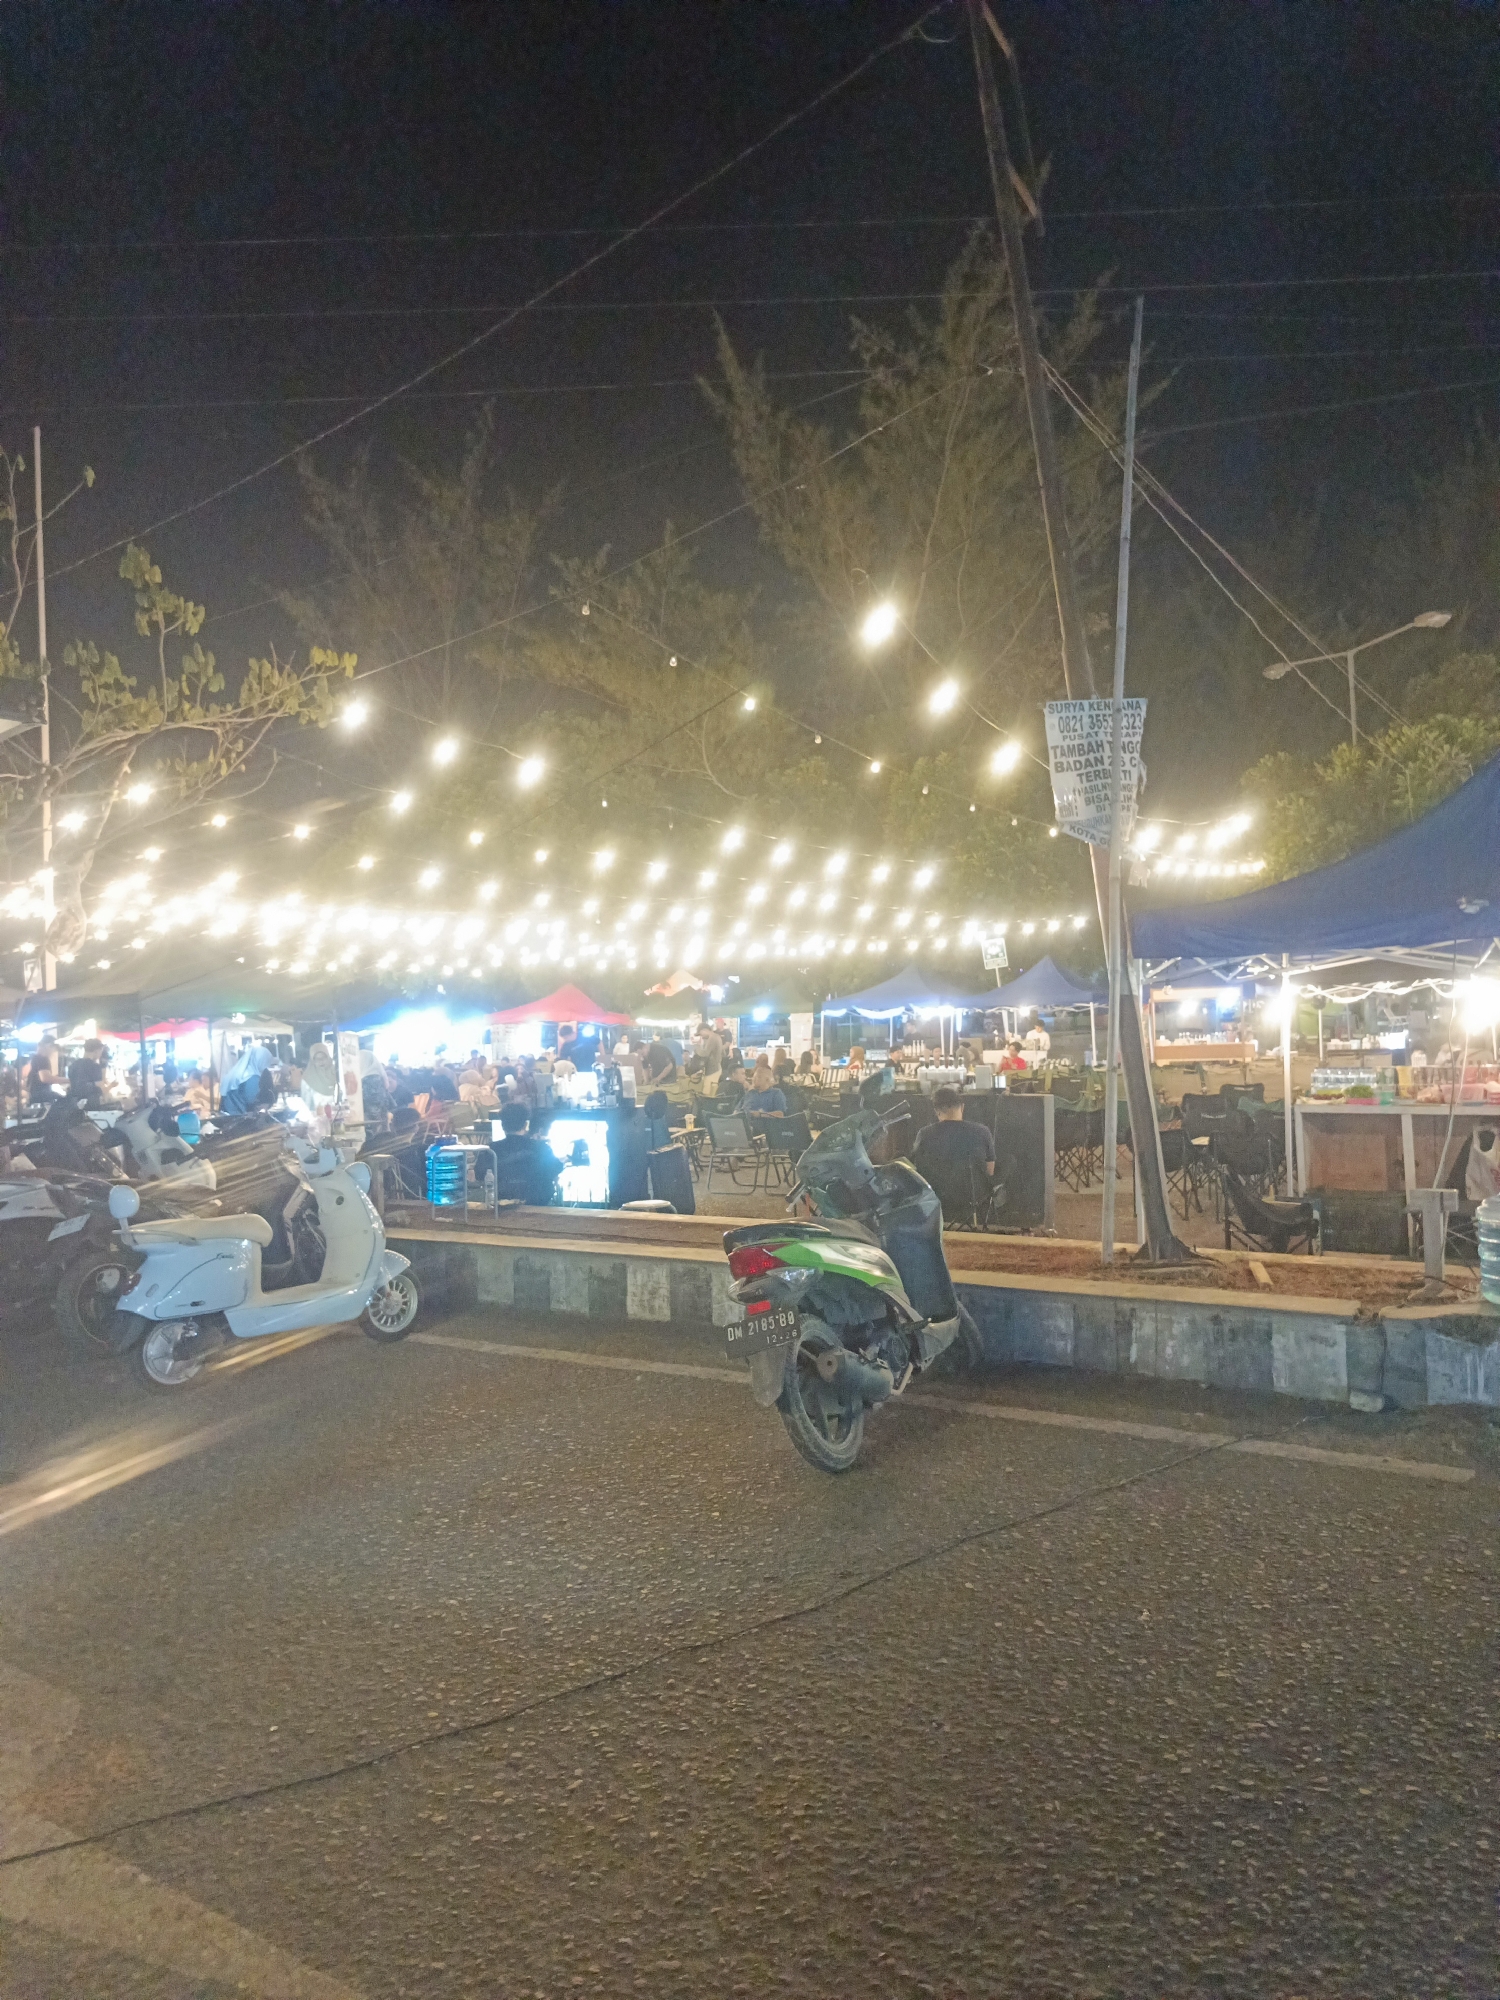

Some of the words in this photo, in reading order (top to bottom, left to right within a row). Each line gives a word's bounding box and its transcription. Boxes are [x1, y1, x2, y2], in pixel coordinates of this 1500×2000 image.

[1048, 702, 1086, 715] SURYA
[1088, 700, 1142, 712] KENANA
[1058, 714, 1084, 733] 0821
[1062, 730, 1100, 742] PUSAT
[1050, 740, 1105, 760] TAMBAH
[1054, 755, 1105, 774] BADAN
[1084, 792, 1111, 807] BISA
[1069, 824, 1097, 841] KOTA
[727, 1326, 743, 1342] DM
[747, 1315, 776, 1336] 2185
